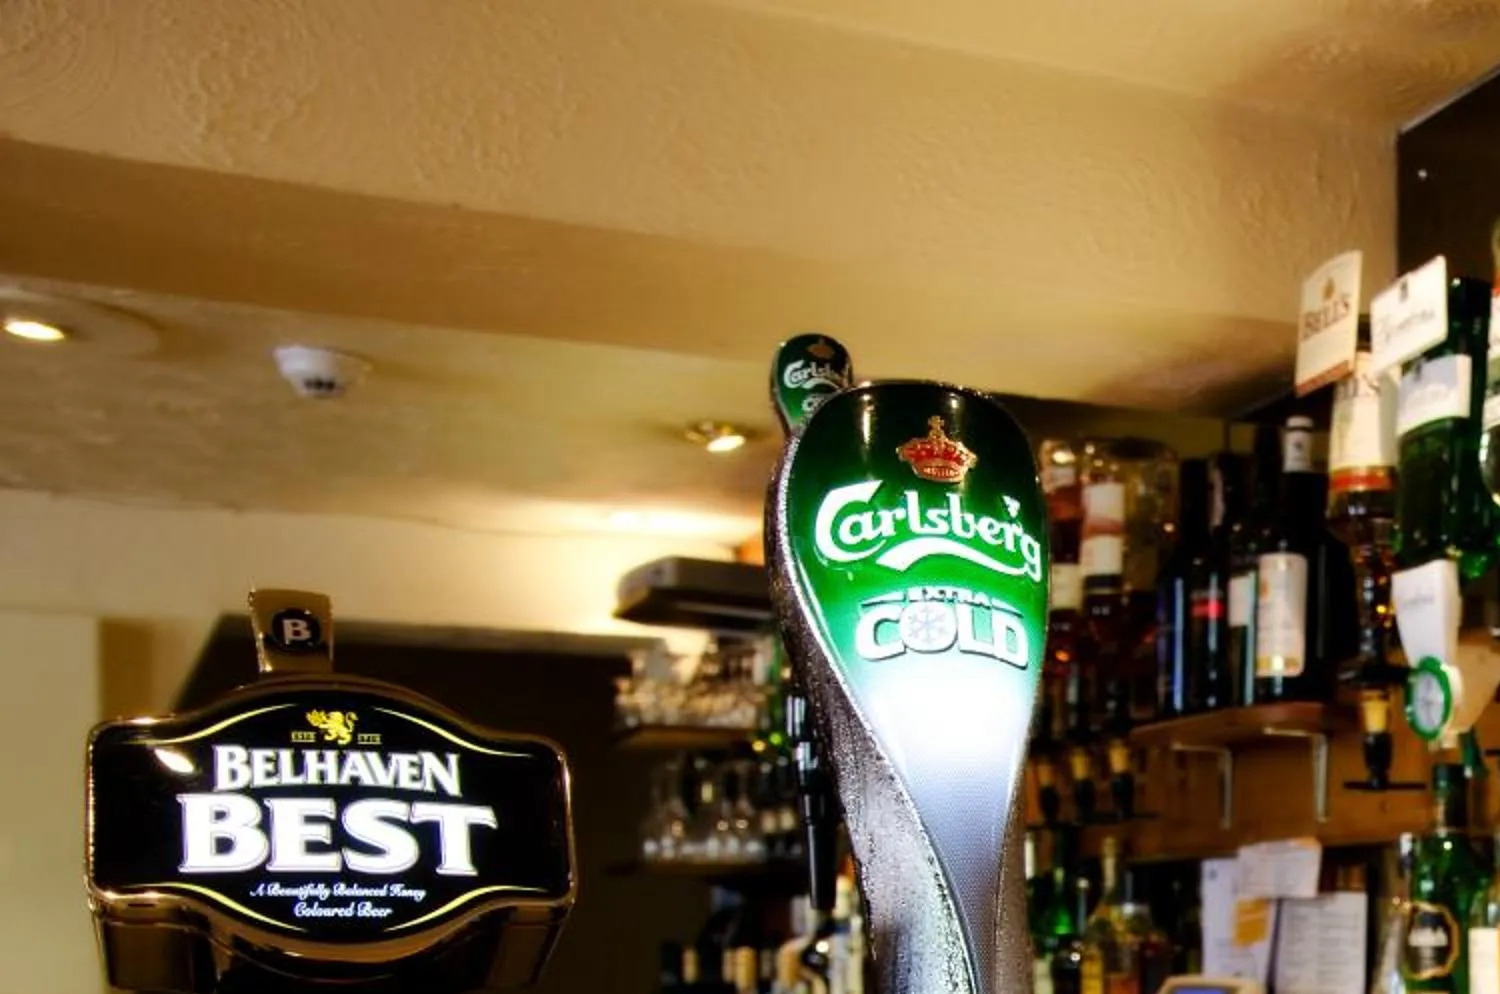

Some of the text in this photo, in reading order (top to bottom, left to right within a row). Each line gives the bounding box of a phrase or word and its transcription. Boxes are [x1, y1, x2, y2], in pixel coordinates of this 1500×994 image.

[815, 480, 1042, 581] Carlsberg
[282, 618, 312, 645] B
[855, 600, 1029, 670] COLD
[212, 744, 463, 797] BELHAVEN
[175, 793, 498, 876] BEST
[250, 884, 265, 897] A
[267, 883, 331, 901] Beautifully
[333, 884, 388, 898] Balanced
[294, 903, 393, 918] Coloured Beer
